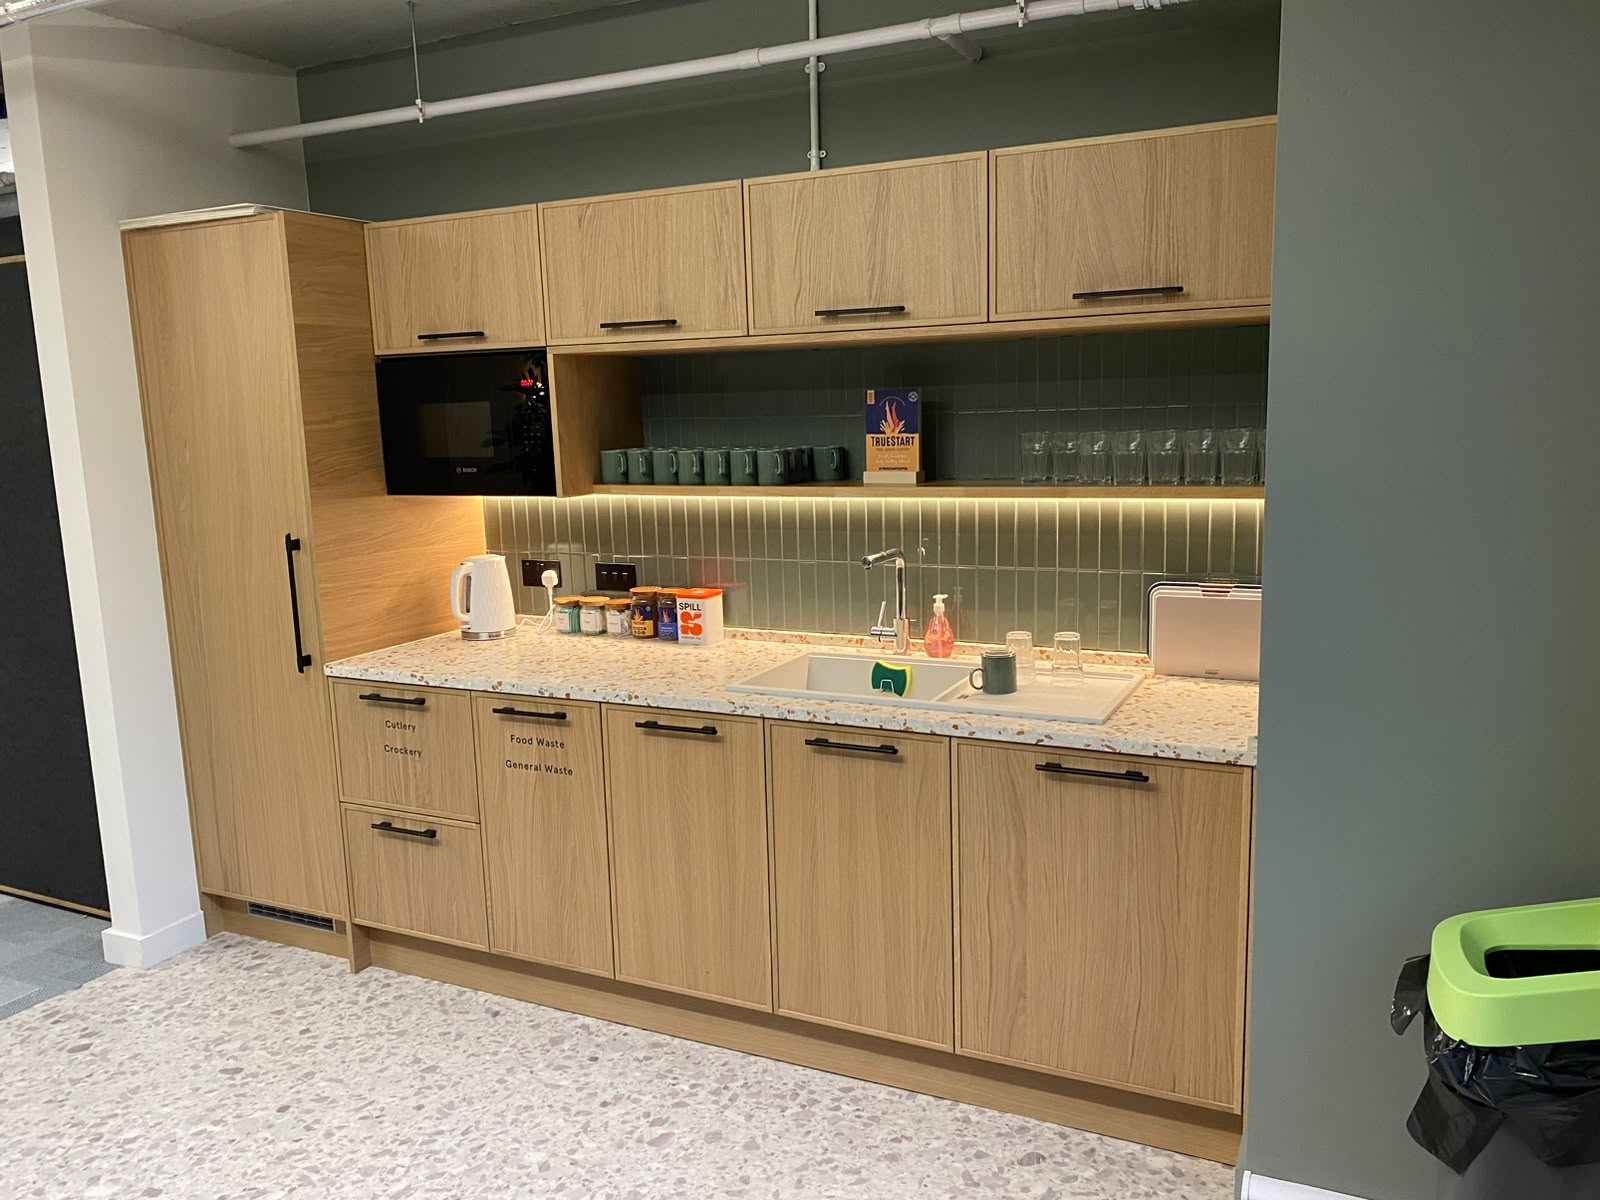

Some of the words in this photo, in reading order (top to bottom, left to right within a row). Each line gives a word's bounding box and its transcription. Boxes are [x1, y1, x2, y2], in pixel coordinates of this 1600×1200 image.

[871, 436, 915, 447] TRUESTART
[678, 602, 702, 611] SPILL
[385, 720, 416, 733] Cutlery
[510, 734, 533, 746] Food
[535, 737, 565, 749] Waste
[383, 744, 422, 758] Crockery
[505, 759, 542, 772] General
[544, 763, 574, 776] Waste
